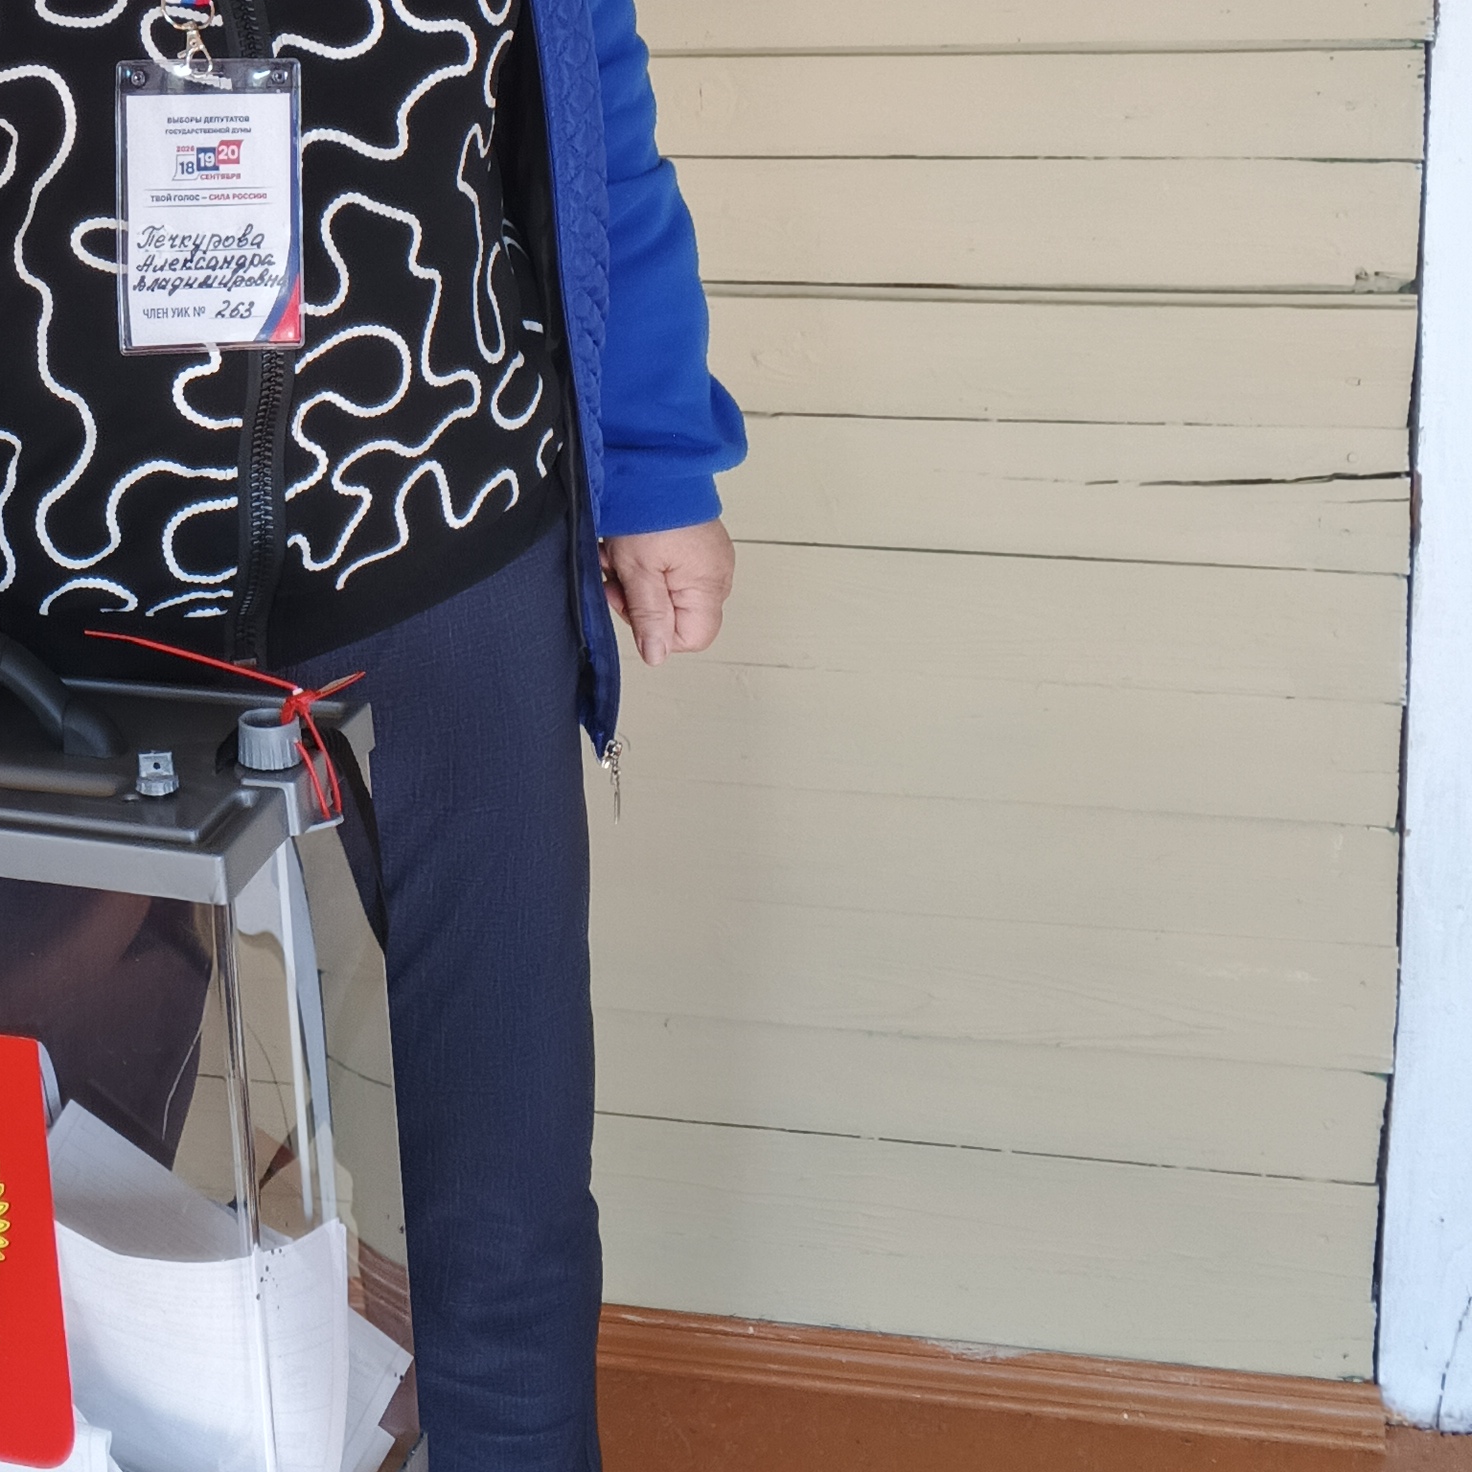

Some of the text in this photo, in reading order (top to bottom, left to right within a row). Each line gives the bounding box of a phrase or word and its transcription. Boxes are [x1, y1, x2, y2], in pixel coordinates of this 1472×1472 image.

[167, 115, 250, 124] ВЫБОРЫ ДЕПУТАТОВ
[179, 145, 239, 175] 18 19 20
[150, 193, 231, 202] ТВОЙ ГОЛОС СИЛА
[137, 223, 265, 257] Печкурова
[136, 252, 276, 274] Александра
[142, 306, 191, 320] ЧЛЕН УИК
[215, 299, 255, 319] 263
